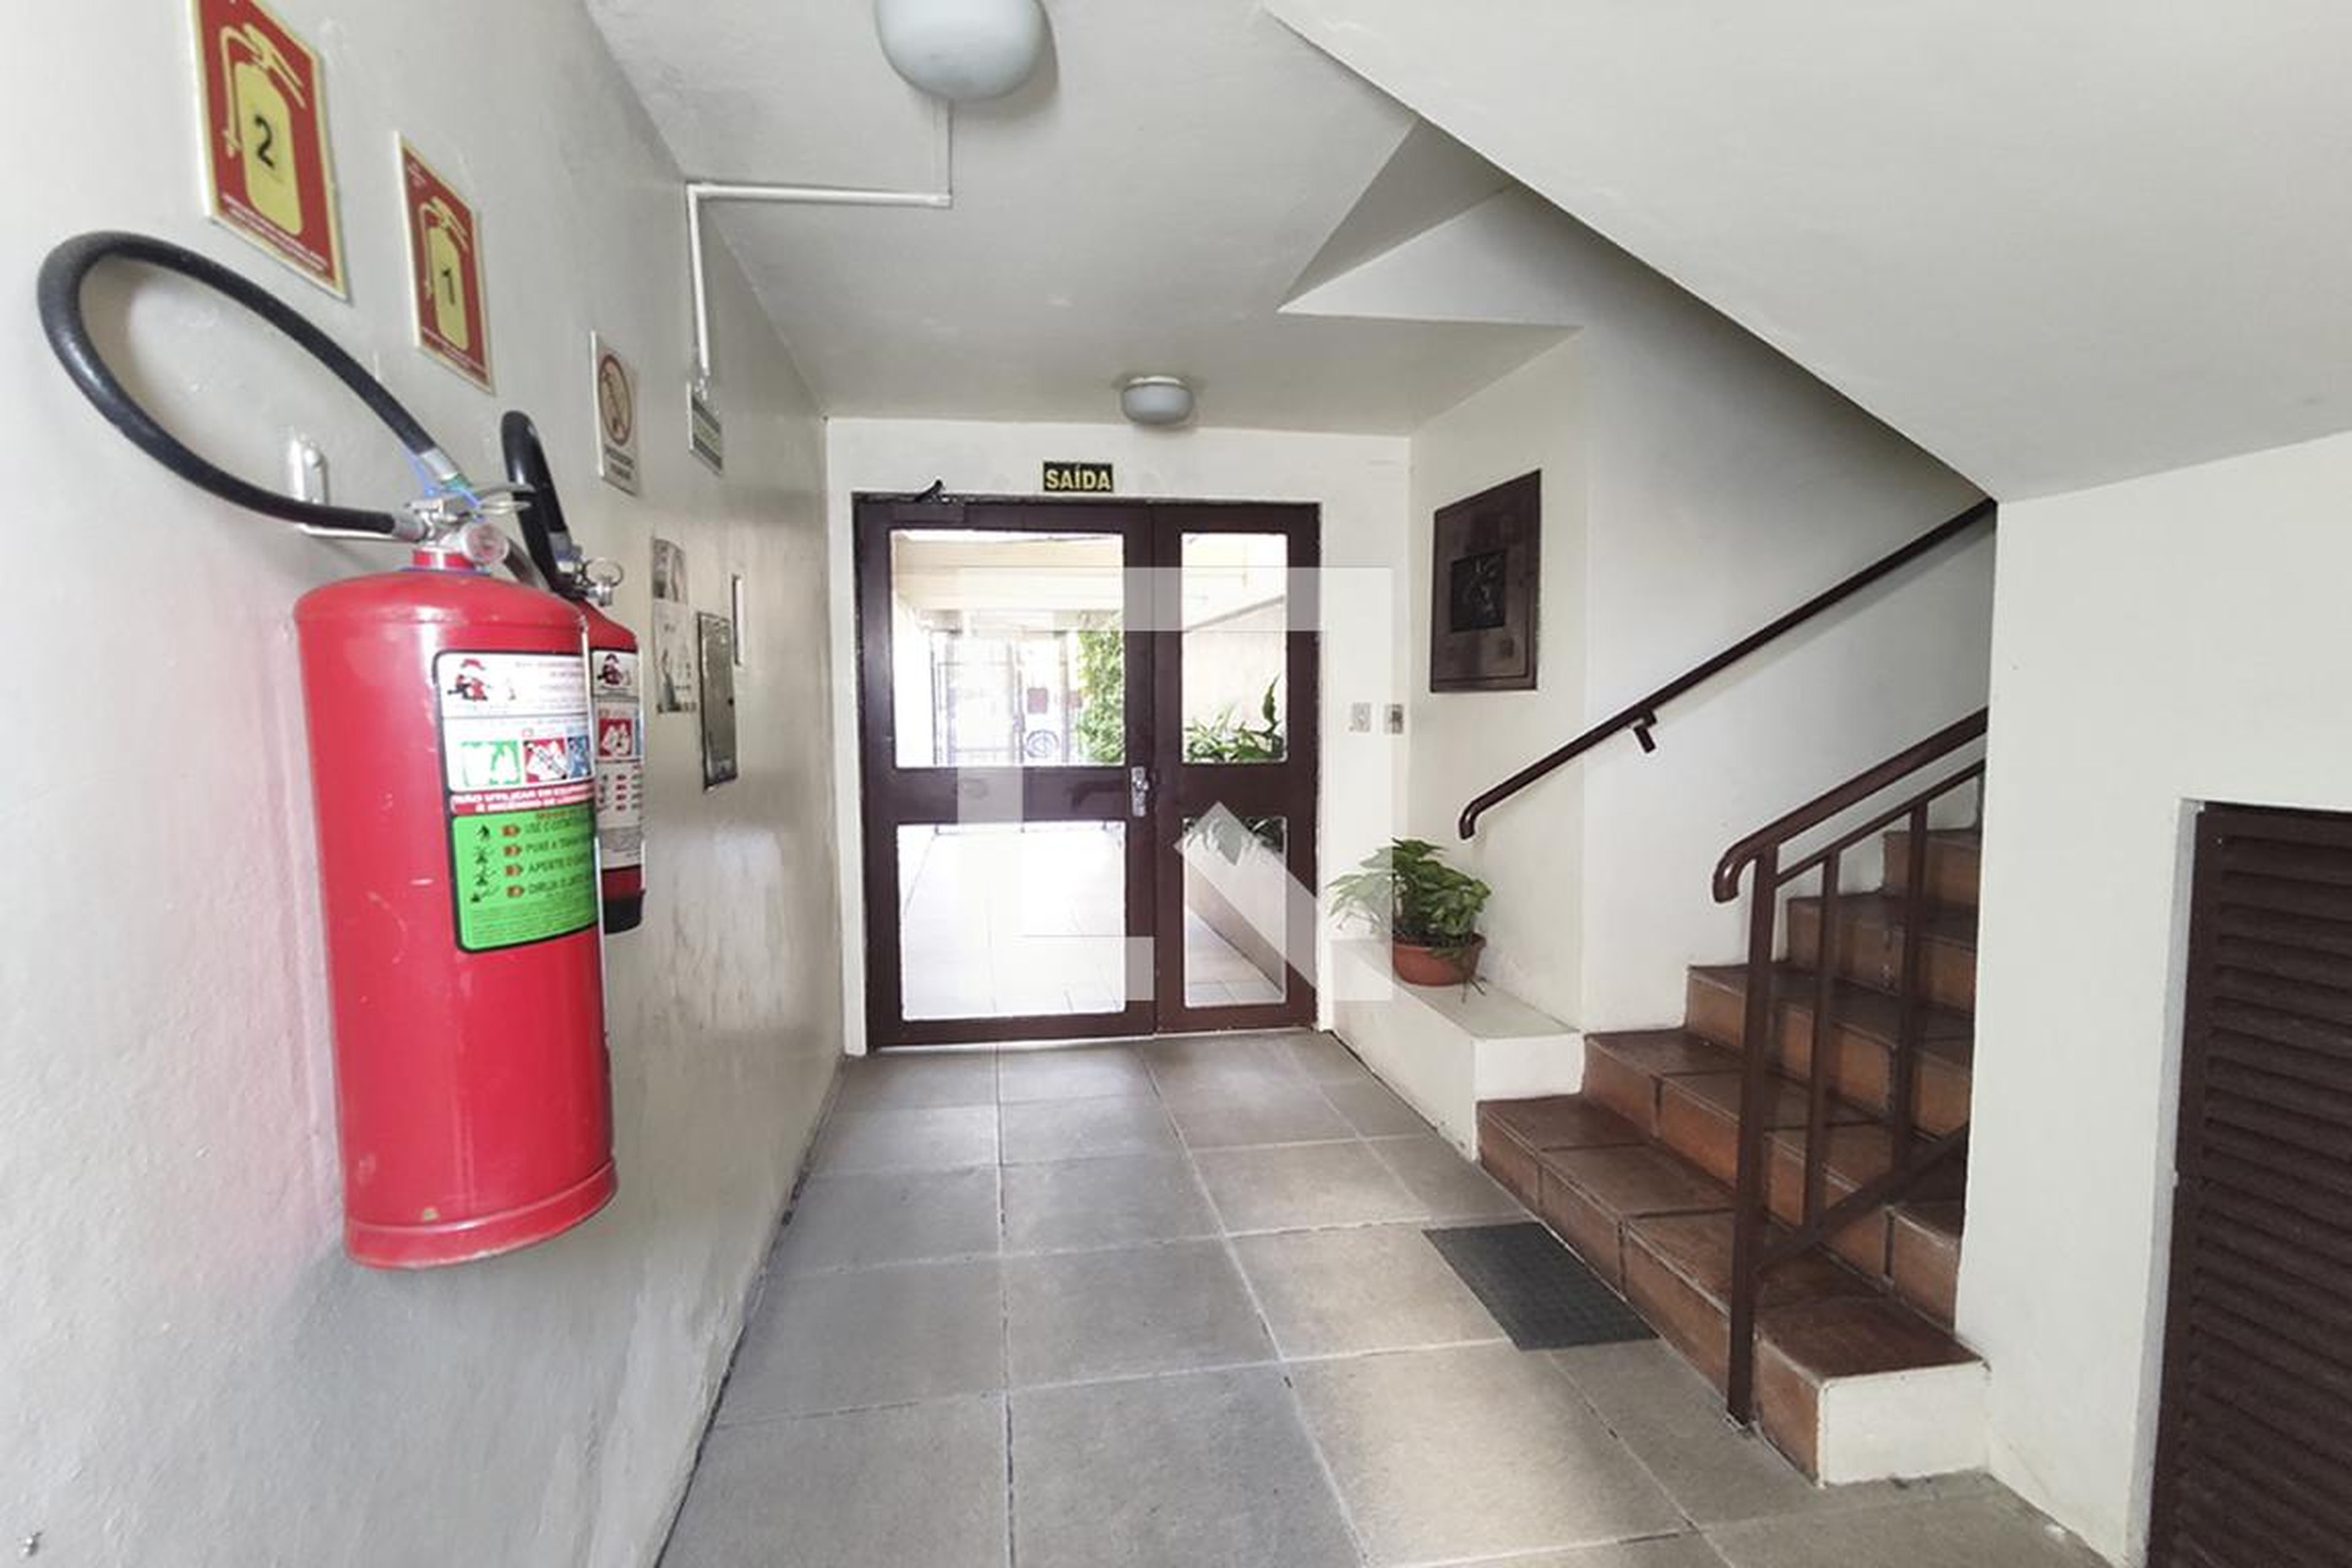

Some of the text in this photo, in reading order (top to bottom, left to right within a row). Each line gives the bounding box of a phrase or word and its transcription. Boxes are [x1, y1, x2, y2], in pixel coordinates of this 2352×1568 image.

[255, 115, 274, 170] 2
[442, 268, 456, 305] 1
[1046, 464, 1110, 489] SAÍDA
